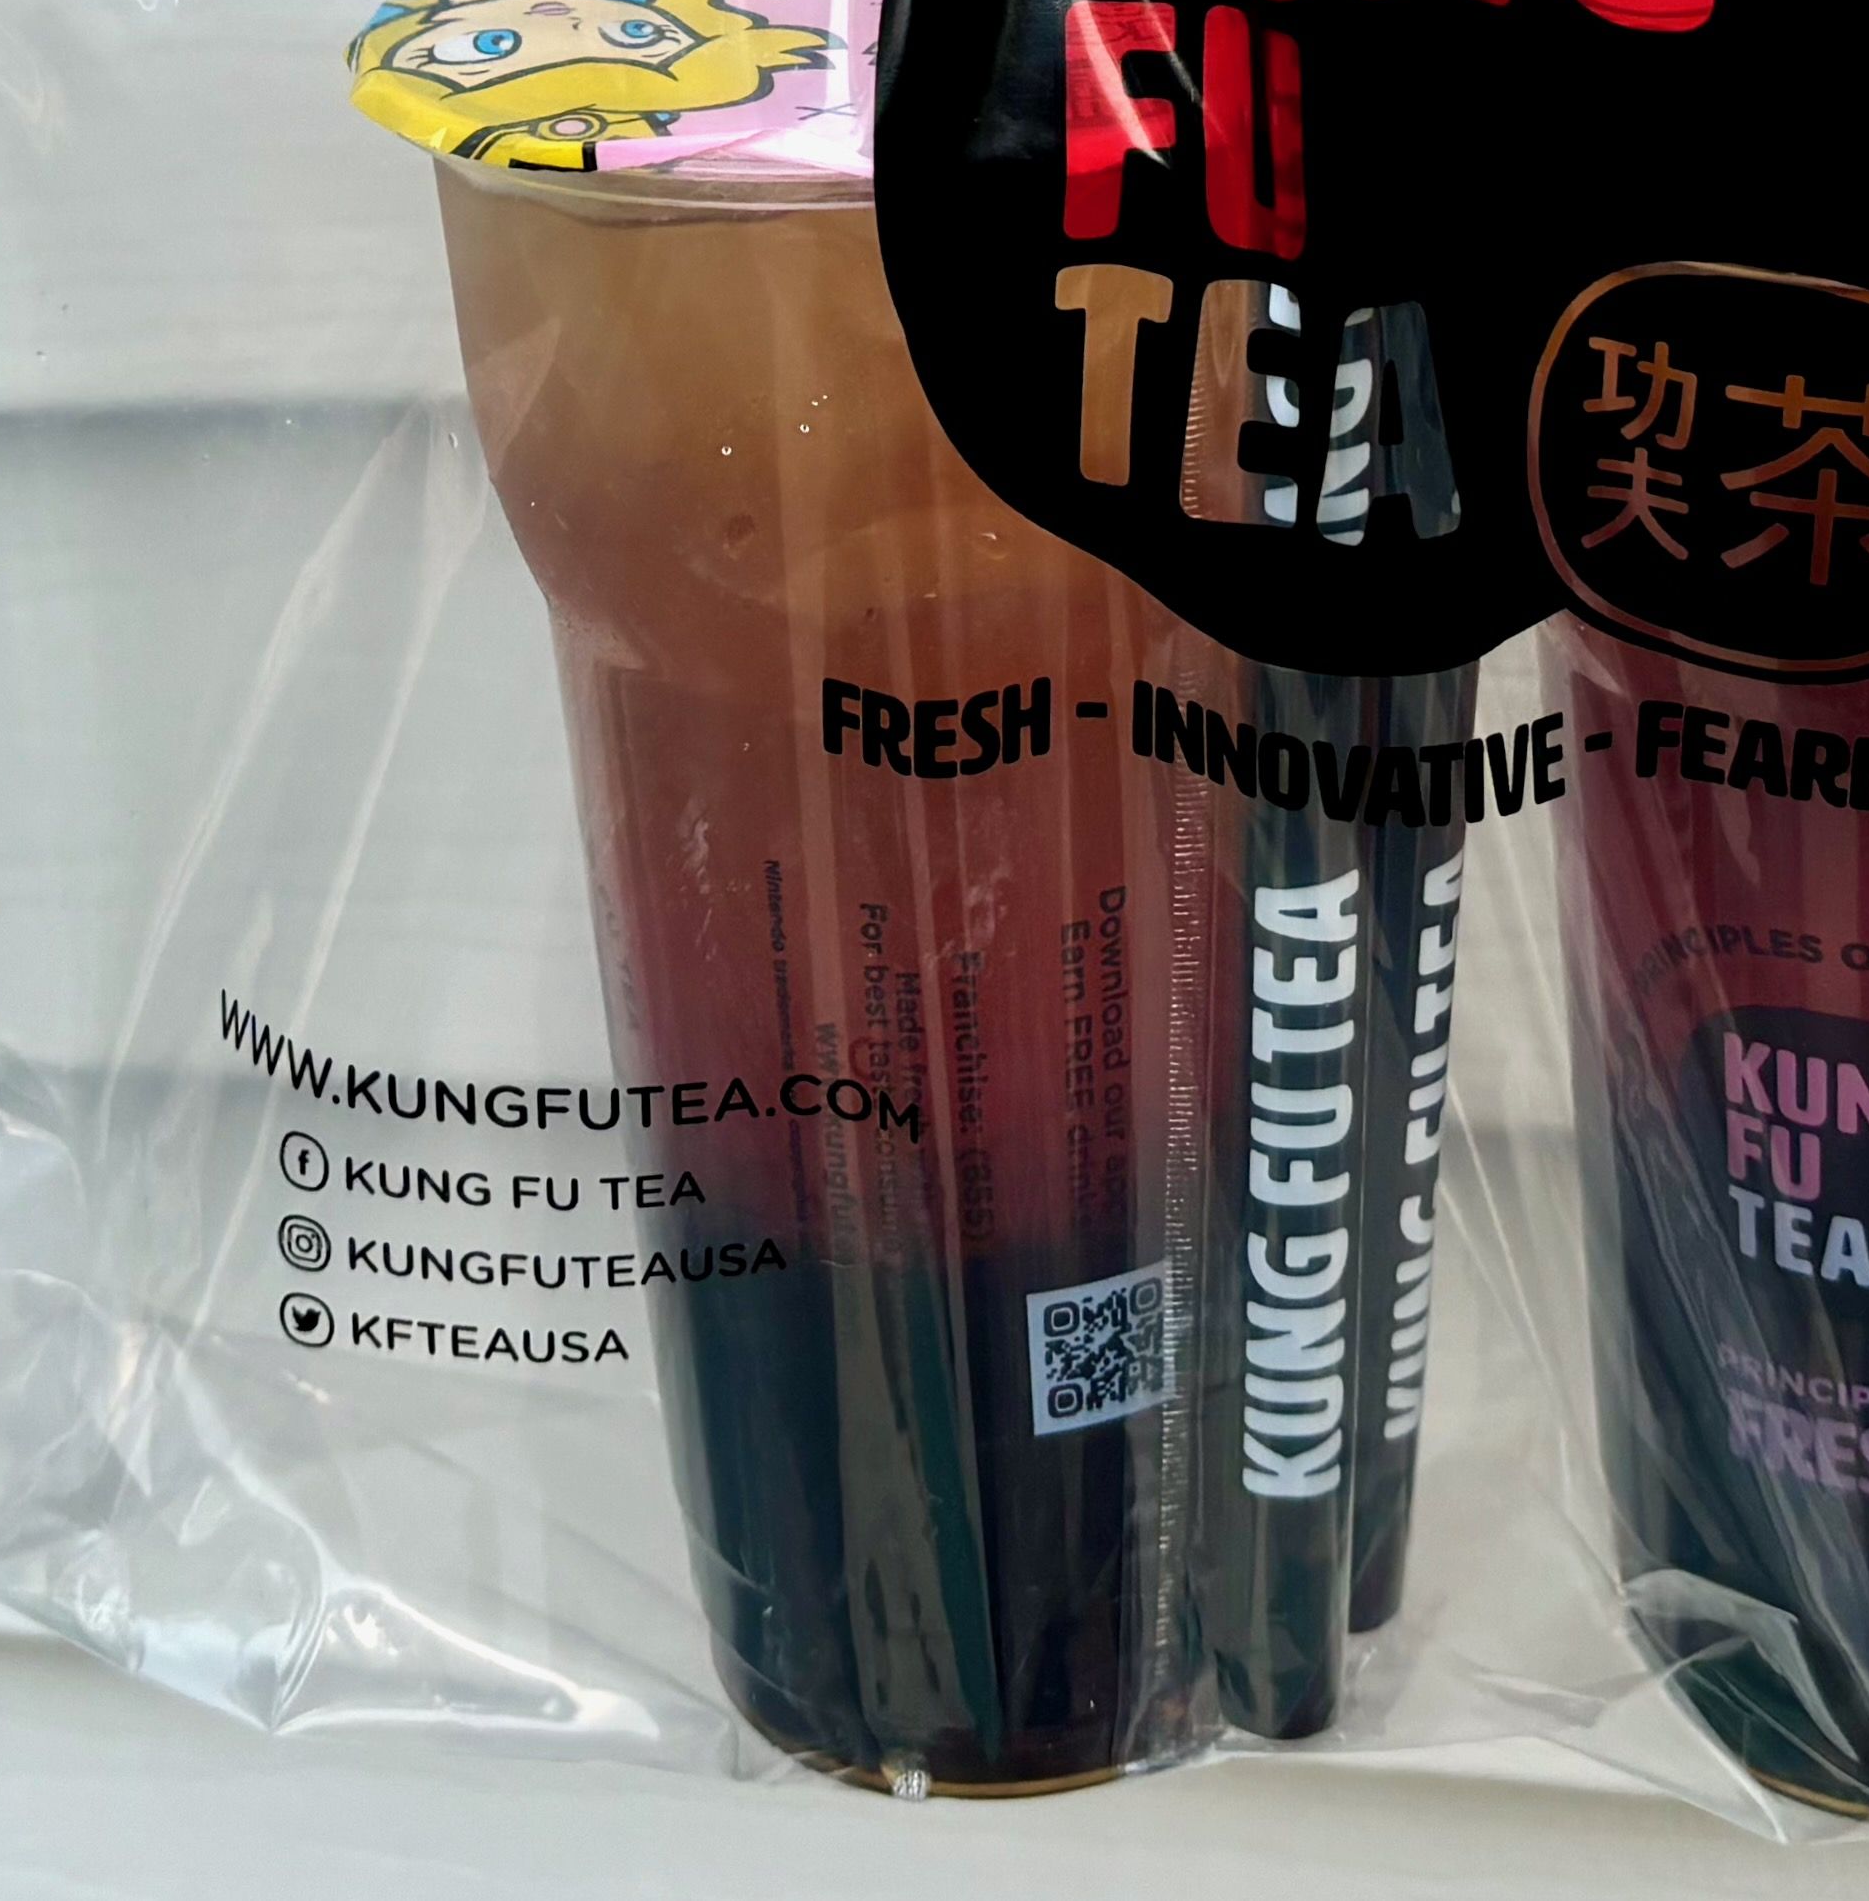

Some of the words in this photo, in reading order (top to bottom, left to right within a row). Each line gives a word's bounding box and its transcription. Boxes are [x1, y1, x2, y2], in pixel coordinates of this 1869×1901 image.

[1063, 0, 1305, 259] FU
[1054, 264, 1461, 546] TEA
[822, 677, 1051, 778] FRESH
[1132, 680, 1567, 828] INNOVATIVE
[859, 901, 886, 954] For
[1061, 918, 1090, 1004] Earn
[1252, 868, 1360, 1064] TEA
[863, 963, 894, 1030] best
[896, 971, 924, 1054] Made
[1099, 884, 1131, 1071] Download
[221, 989, 919, 1143] WWW.KUNGFUTEA.COM
[868, 1041, 898, 1105] tast
[952, 950, 988, 1135] Franchise:
[1064, 1013, 1094, 1108] FREE
[1104, 1082, 1128, 1141] our
[1249, 1079, 1354, 1208] FU
[1727, 1111, 1820, 1202] FU
[345, 1156, 492, 1207] KUNG
[512, 1176, 579, 1211] FU
[599, 1170, 706, 1210] TEA
[348, 1235, 787, 1290] KUNGFUTEAUSA
[352, 1312, 629, 1363] KFTEAUSA
[1242, 1229, 1351, 1499] KUNG
